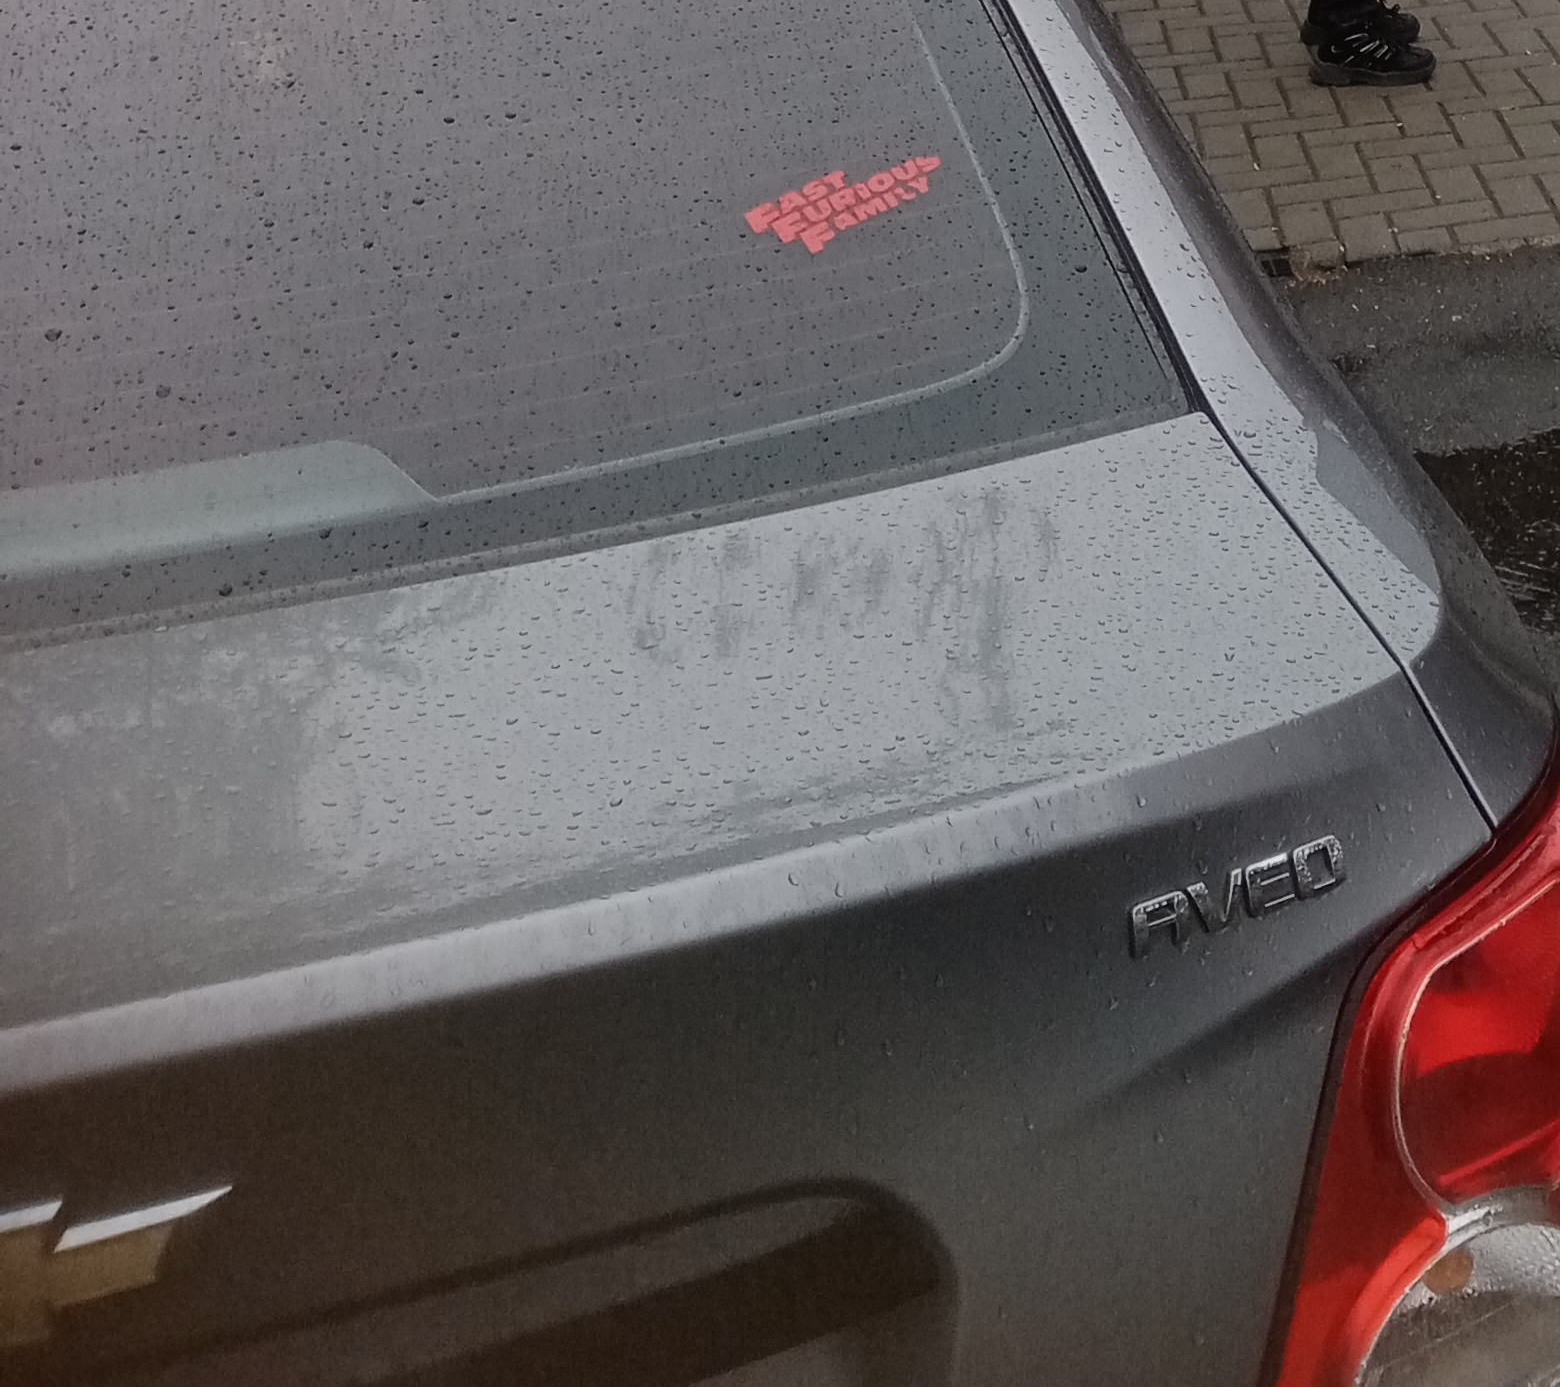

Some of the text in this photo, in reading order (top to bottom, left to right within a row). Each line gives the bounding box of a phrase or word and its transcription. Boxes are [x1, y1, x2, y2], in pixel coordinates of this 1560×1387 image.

[744, 170, 846, 234] FAST
[770, 155, 942, 244] FURIOUS
[1127, 834, 1344, 959] AVEO
